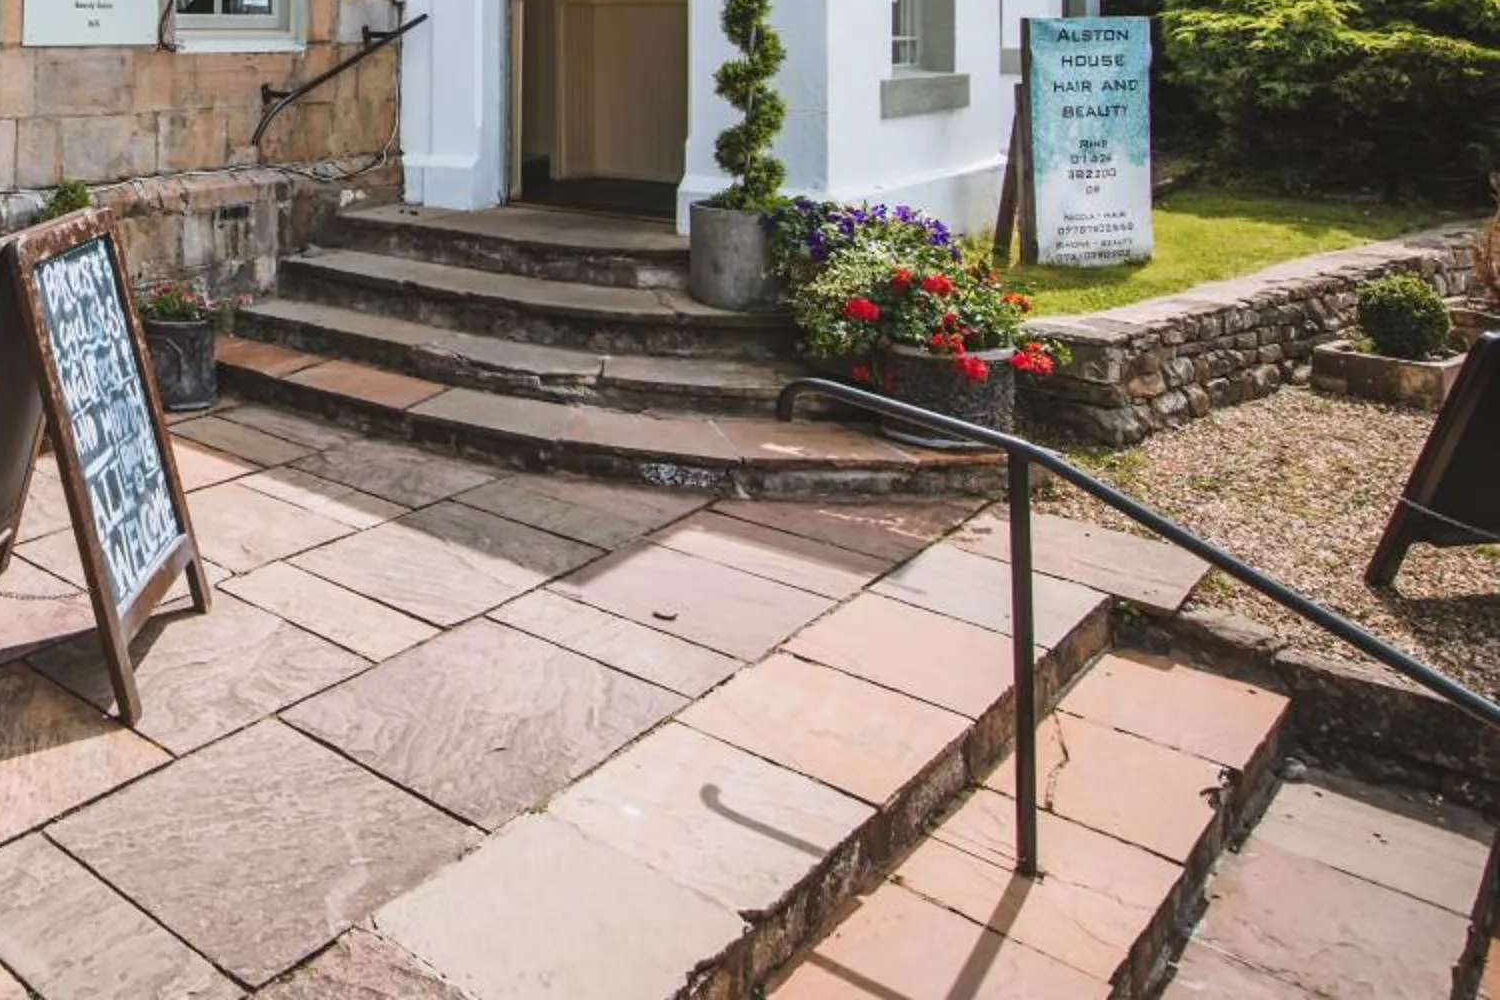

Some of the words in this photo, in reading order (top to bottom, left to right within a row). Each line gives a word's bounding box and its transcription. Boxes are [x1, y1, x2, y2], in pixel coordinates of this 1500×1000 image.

[1057, 27, 1130, 42] ALSTON
[1061, 54, 1126, 68] HOUSE
[1053, 80, 1093, 93] HAIR
[1101, 79, 1139, 92] AND
[1061, 104, 1129, 119] BEAUTY
